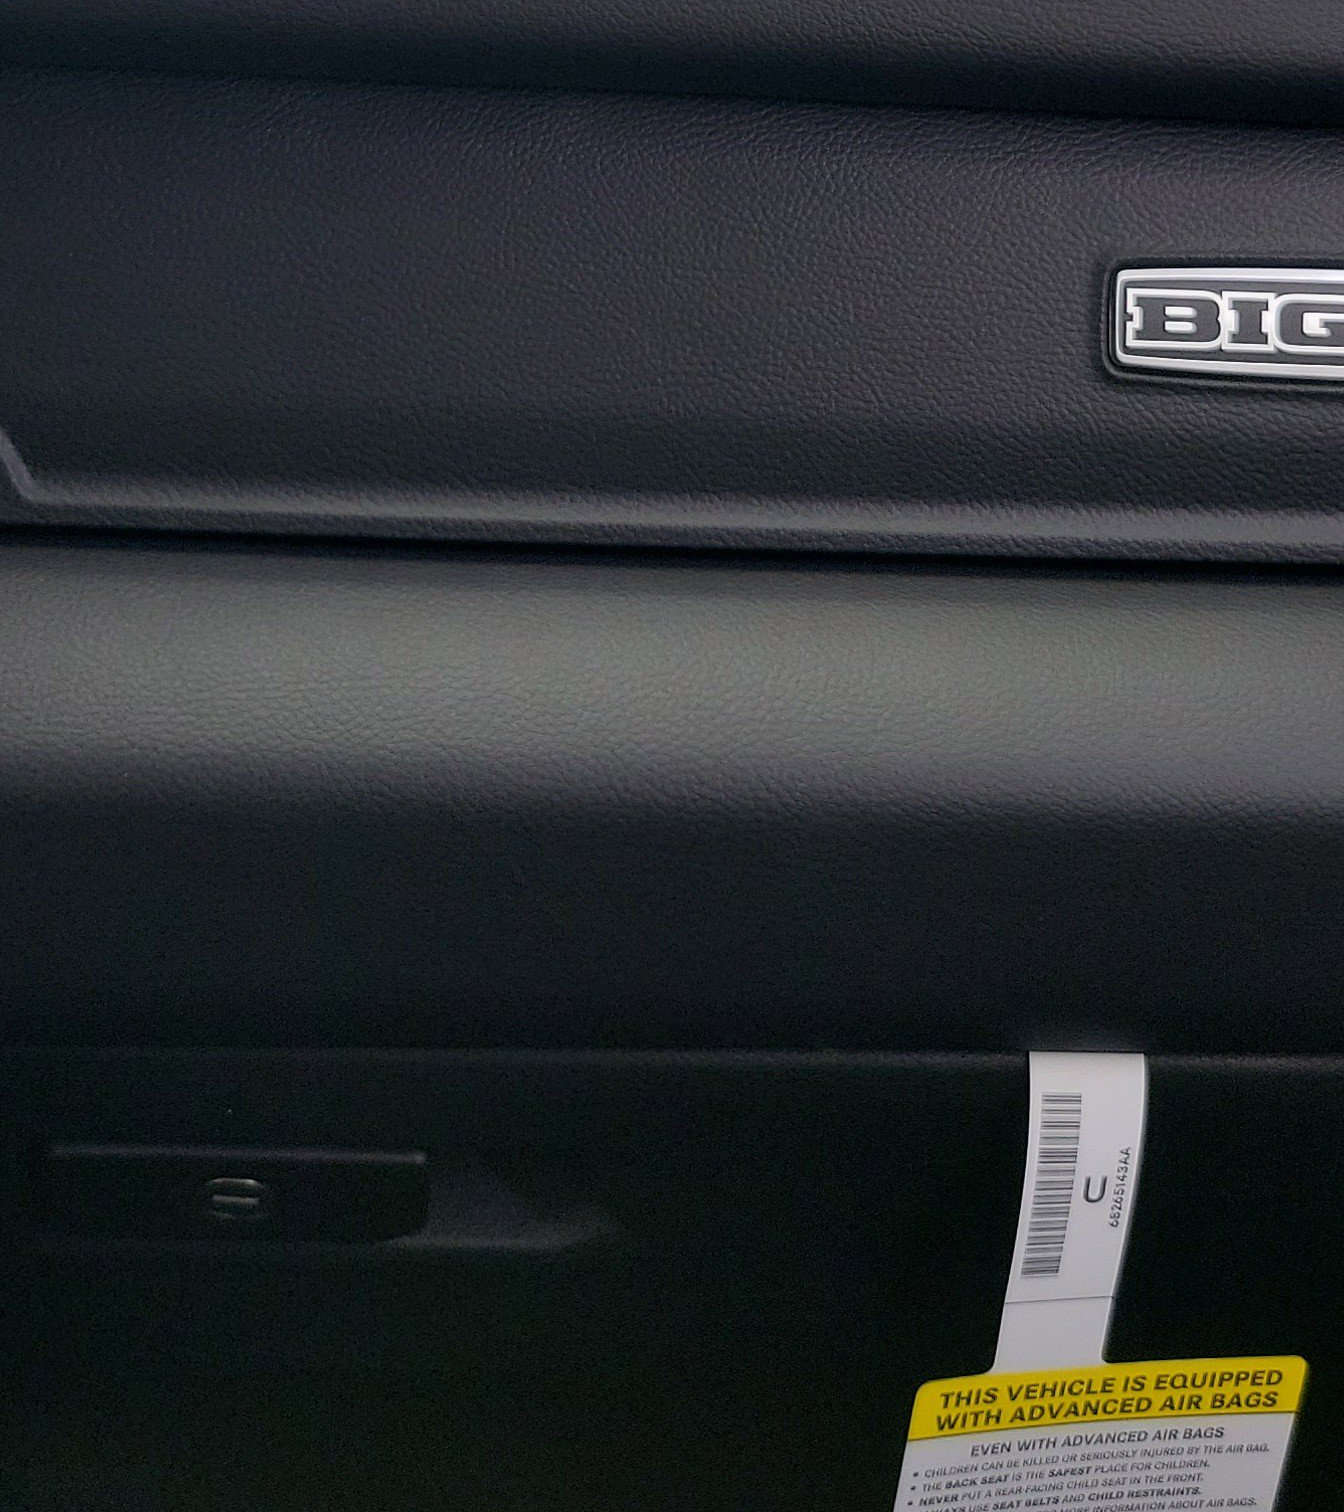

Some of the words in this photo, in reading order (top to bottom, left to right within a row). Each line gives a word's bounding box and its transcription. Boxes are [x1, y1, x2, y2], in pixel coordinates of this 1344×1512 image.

[1083, 1175, 1108, 1203] U
[1109, 1147, 1131, 1228] 68265143AA
[940, 1387, 999, 1409] THIS
[1007, 1377, 1116, 1402] VEHICLE
[1122, 1375, 1147, 1392] IS
[1154, 1369, 1283, 1390] EQUIPPED
[936, 1408, 1002, 1431] WITH
[1009, 1396, 1152, 1424] ADVANCED
[1159, 1394, 1203, 1411] AIR
[1210, 1391, 1278, 1409] BAGS
[970, 1441, 1012, 1457] EVEN
[1017, 1436, 1057, 1452] WITH
[1061, 1430, 1148, 1447] ADVANCED
[1153, 1427, 1178, 1442] AIR
[1182, 1426, 1224, 1440] BAGS
[922, 1481, 943, 1492] THE
[945, 1477, 978, 1489] BACK
[980, 1473, 1009, 1484] SEAT
[1011, 1472, 1022, 1482] IS
[1025, 1470, 1045, 1480] THE
[1048, 1466, 1092, 1478] SAFEST
[1094, 1463, 1129, 1473] PLACE
[1130, 1461, 1152, 1471] FOR
[924, 1462, 978, 1478] CHILDREN
[981, 1459, 1004, 1470] CAN
[1022, 1455, 1060, 1467] KILLED
[1061, 1453, 1078, 1463] OR
[1080, 1449, 1137, 1461] SERIOUSLY
[1140, 1446, 1184, 1458] INJURED
[1186, 1446, 1201, 1455] BY
[1204, 1445, 1223, 1454] THE
[1225, 1444, 1244, 1453] AIR
[919, 1493, 958, 1506] NEVER
[961, 1490, 982, 1501] PUT
[984, 1489, 992, 1498] A
[994, 1486, 1022, 1497] REAR
[1025, 1481, 1064, 1493] FACING
[1066, 1478, 1099, 1489] CHILD
[1100, 1476, 1128, 1487] SEAT
[1129, 1475, 1142, 1485] IN
[1145, 1474, 1165, 1484] THE
[992, 1499, 1022, 1510] SEAT
[1024, 1495, 1060, 1507] BELTS
[1061, 1493, 1085, 1504] AND
[1087, 1490, 1124, 1502] CHILD
[1168, 1499, 1204, 1509] ABOUT
[1205, 1498, 1225, 1507] AIR
